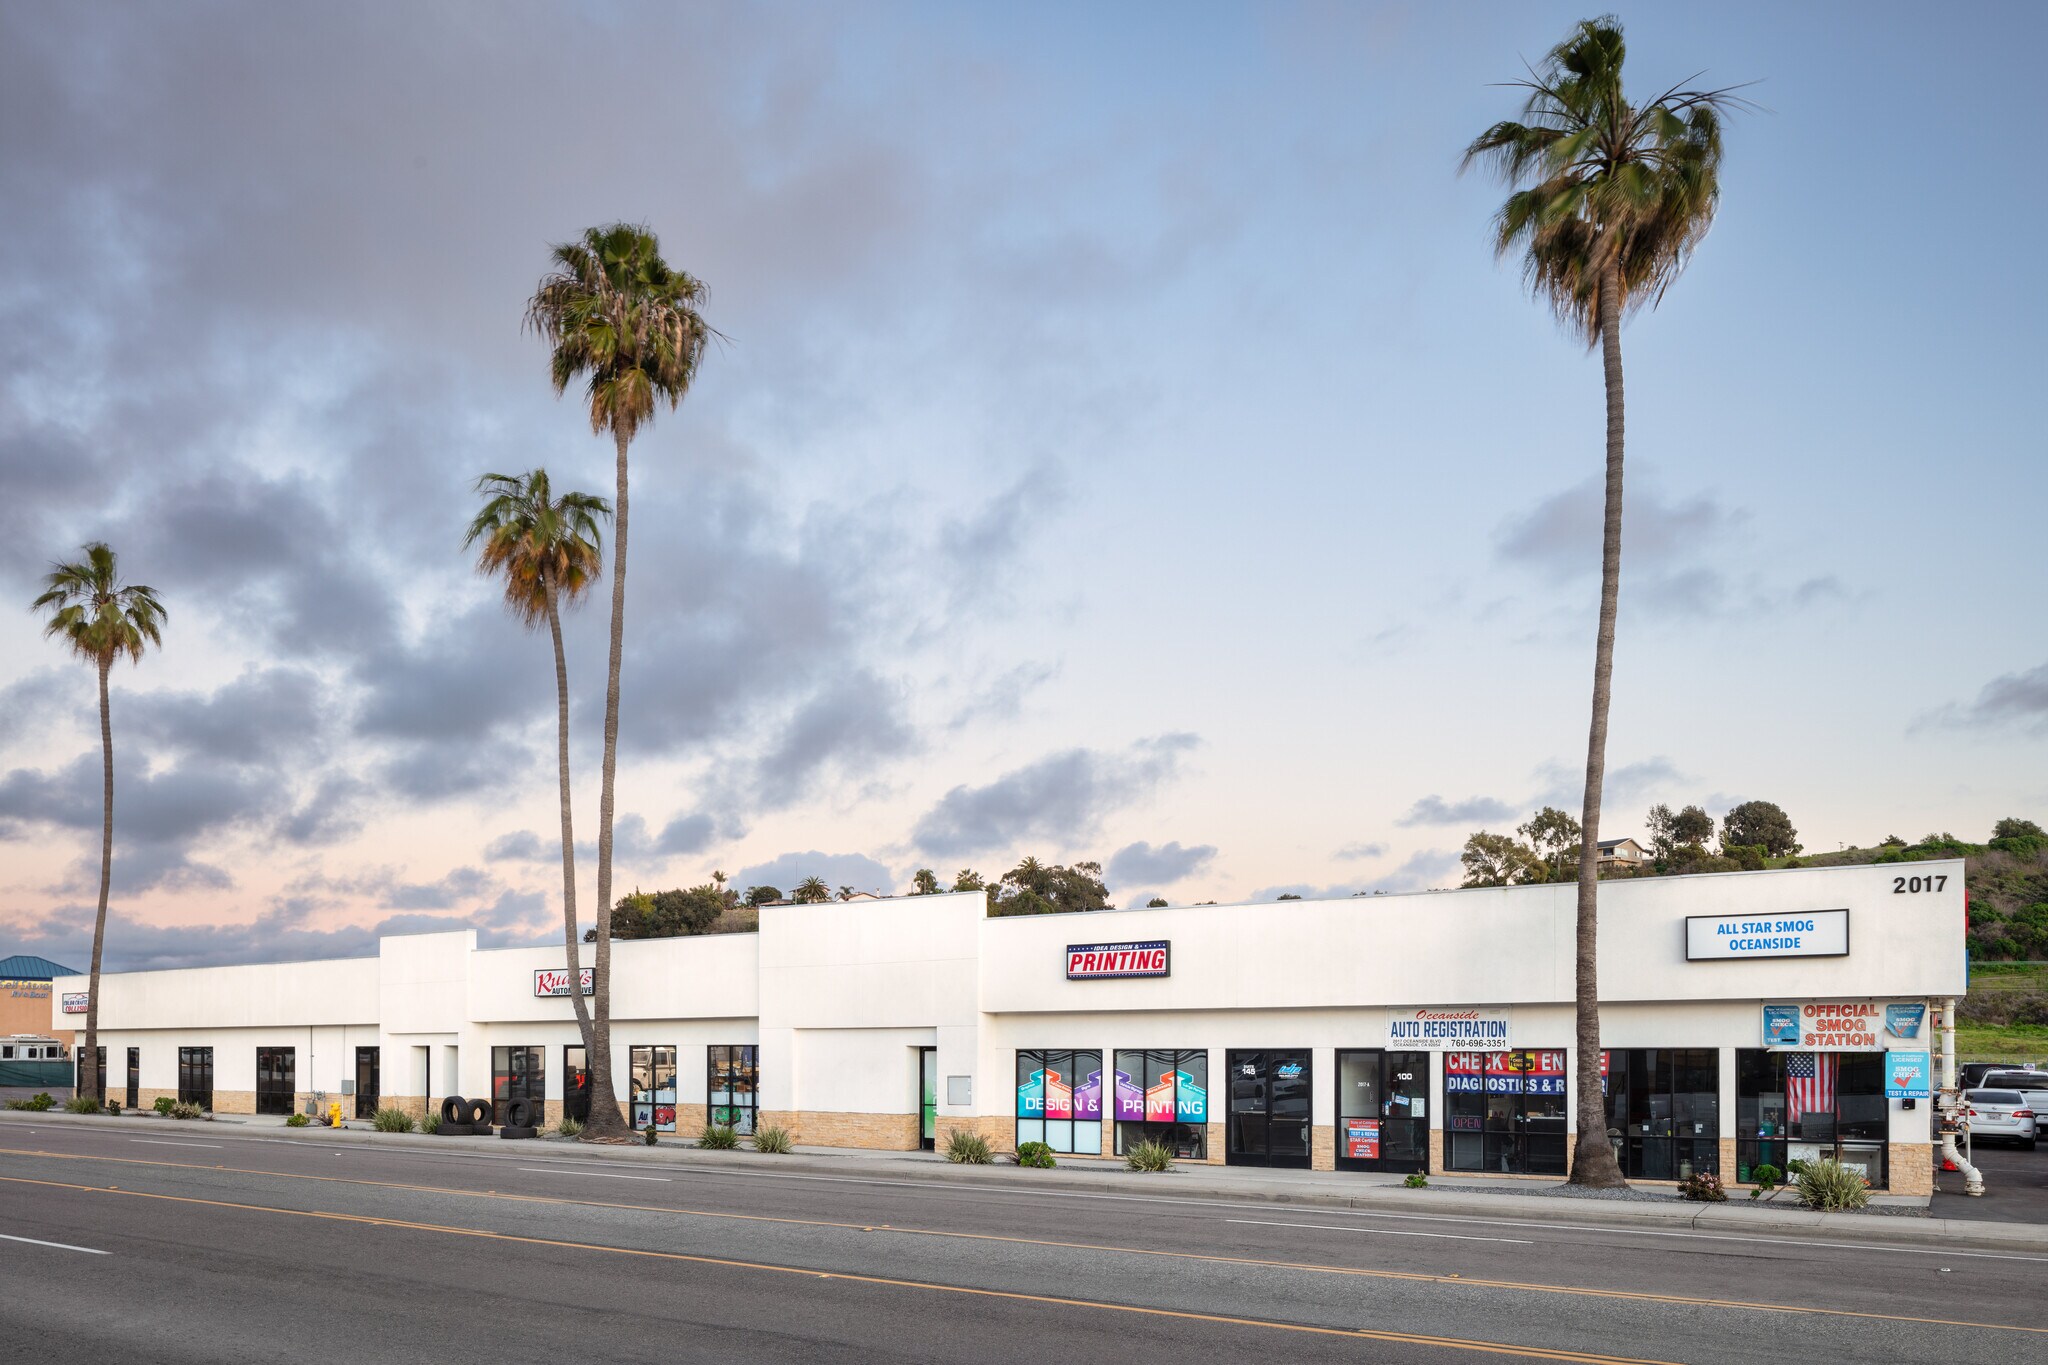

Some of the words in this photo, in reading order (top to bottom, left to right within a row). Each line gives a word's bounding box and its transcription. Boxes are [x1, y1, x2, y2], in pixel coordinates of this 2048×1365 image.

[1893, 875, 1948, 894] 2017
[1717, 923, 1739, 935] ALL
[1742, 922, 1772, 934] STAR
[1775, 920, 1814, 933] SMOG
[1729, 938, 1801, 950] OCEANSIDE
[1069, 950, 1165, 972] PRINTING
[537, 970, 592, 994] Ru's
[1416, 1009, 1479, 1020] Oceanside
[1804, 1004, 1879, 1018] OFFICIAL
[1391, 1021, 1420, 1038] AUTO
[1424, 1021, 1507, 1038] REGISTRATION
[1816, 1019, 1867, 1031] SMOG
[1451, 1039, 1506, 1047] 760-696-3351
[1805, 1033, 1875, 1046] STATION
[1448, 1052, 1503, 1071] CHECK
[1397, 1072, 1412, 1080] 100
[1448, 1077, 1537, 1092] DIAGNOSTICS
[1543, 1078, 1551, 1092] &
[1025, 1097, 1082, 1111] DESIGN
[1087, 1099, 1099, 1111] &
[1123, 1100, 1203, 1114] PRINTING
[1453, 1117, 1481, 1128] OPEN
